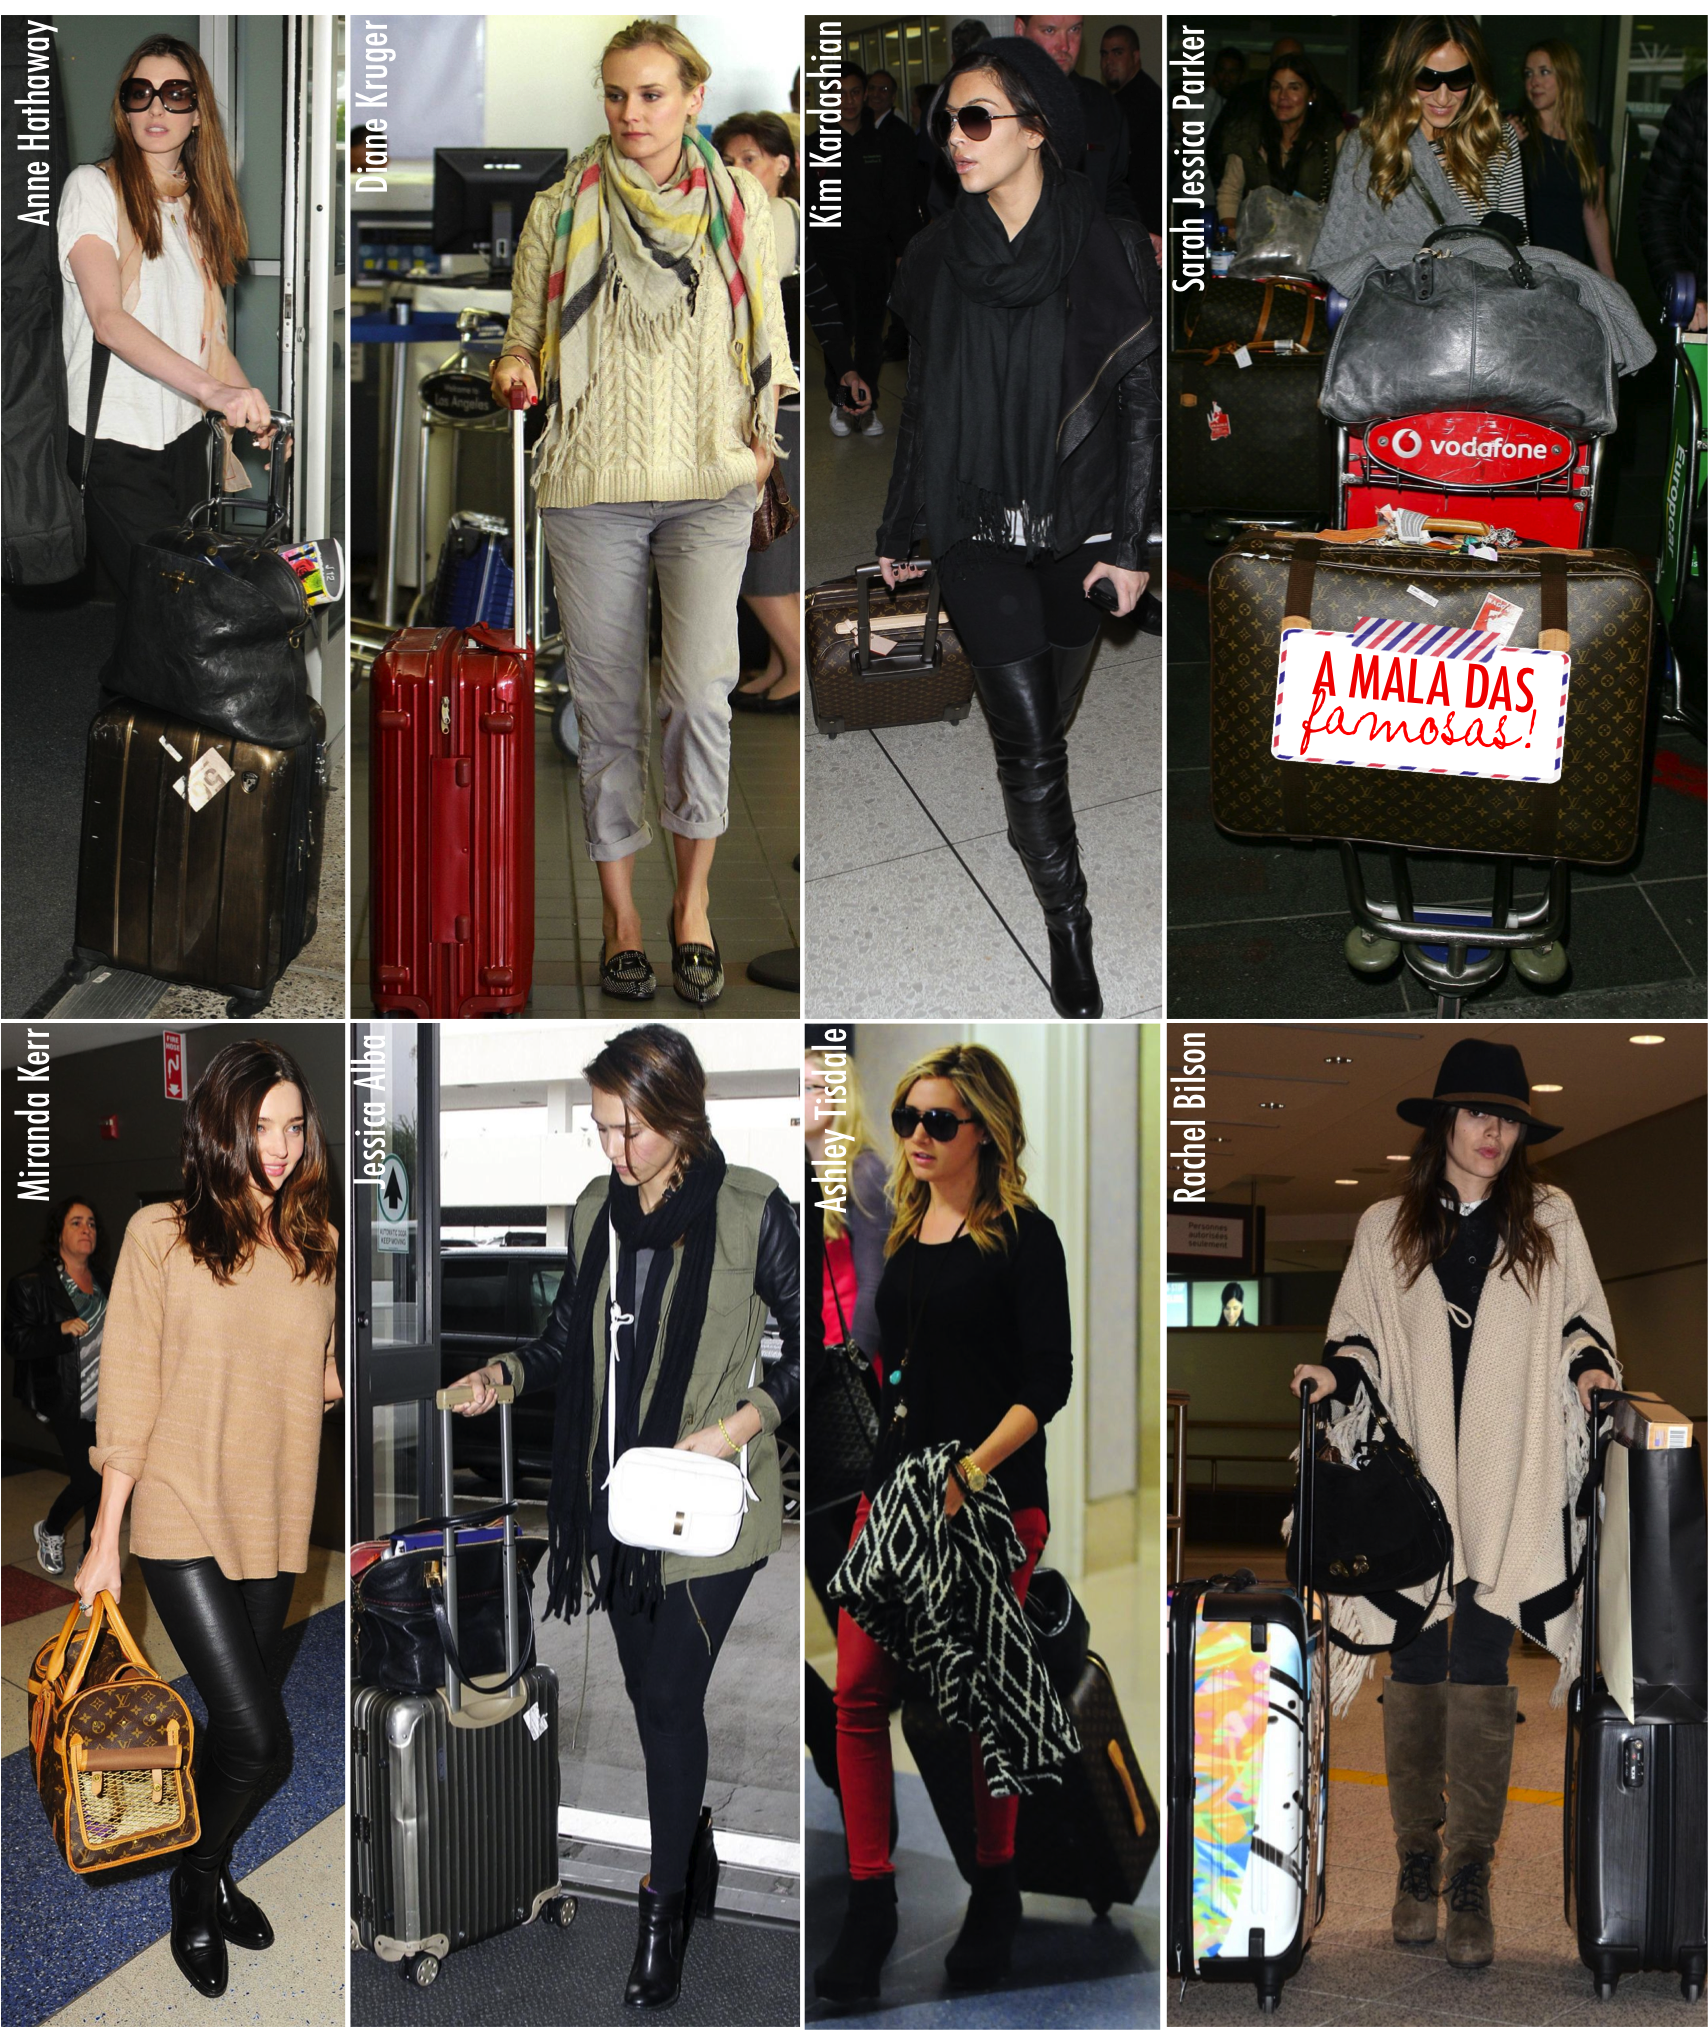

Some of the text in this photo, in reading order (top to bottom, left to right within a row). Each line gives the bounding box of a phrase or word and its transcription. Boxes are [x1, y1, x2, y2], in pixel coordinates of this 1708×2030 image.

[434, 393, 490, 412] Los Angeles
[1430, 436, 1547, 460] vodafone
[1667, 444, 1686, 559] Europcar
[166, 1034, 179, 1044] FIRE
[165, 1042, 180, 1052] HOSE
[1188, 1221, 1228, 1232] Personnes
[1188, 1231, 1228, 1240] autorisées
[380, 1237, 406, 1246] KEEP MOVING
[1188, 1240, 1228, 1249] seulement
